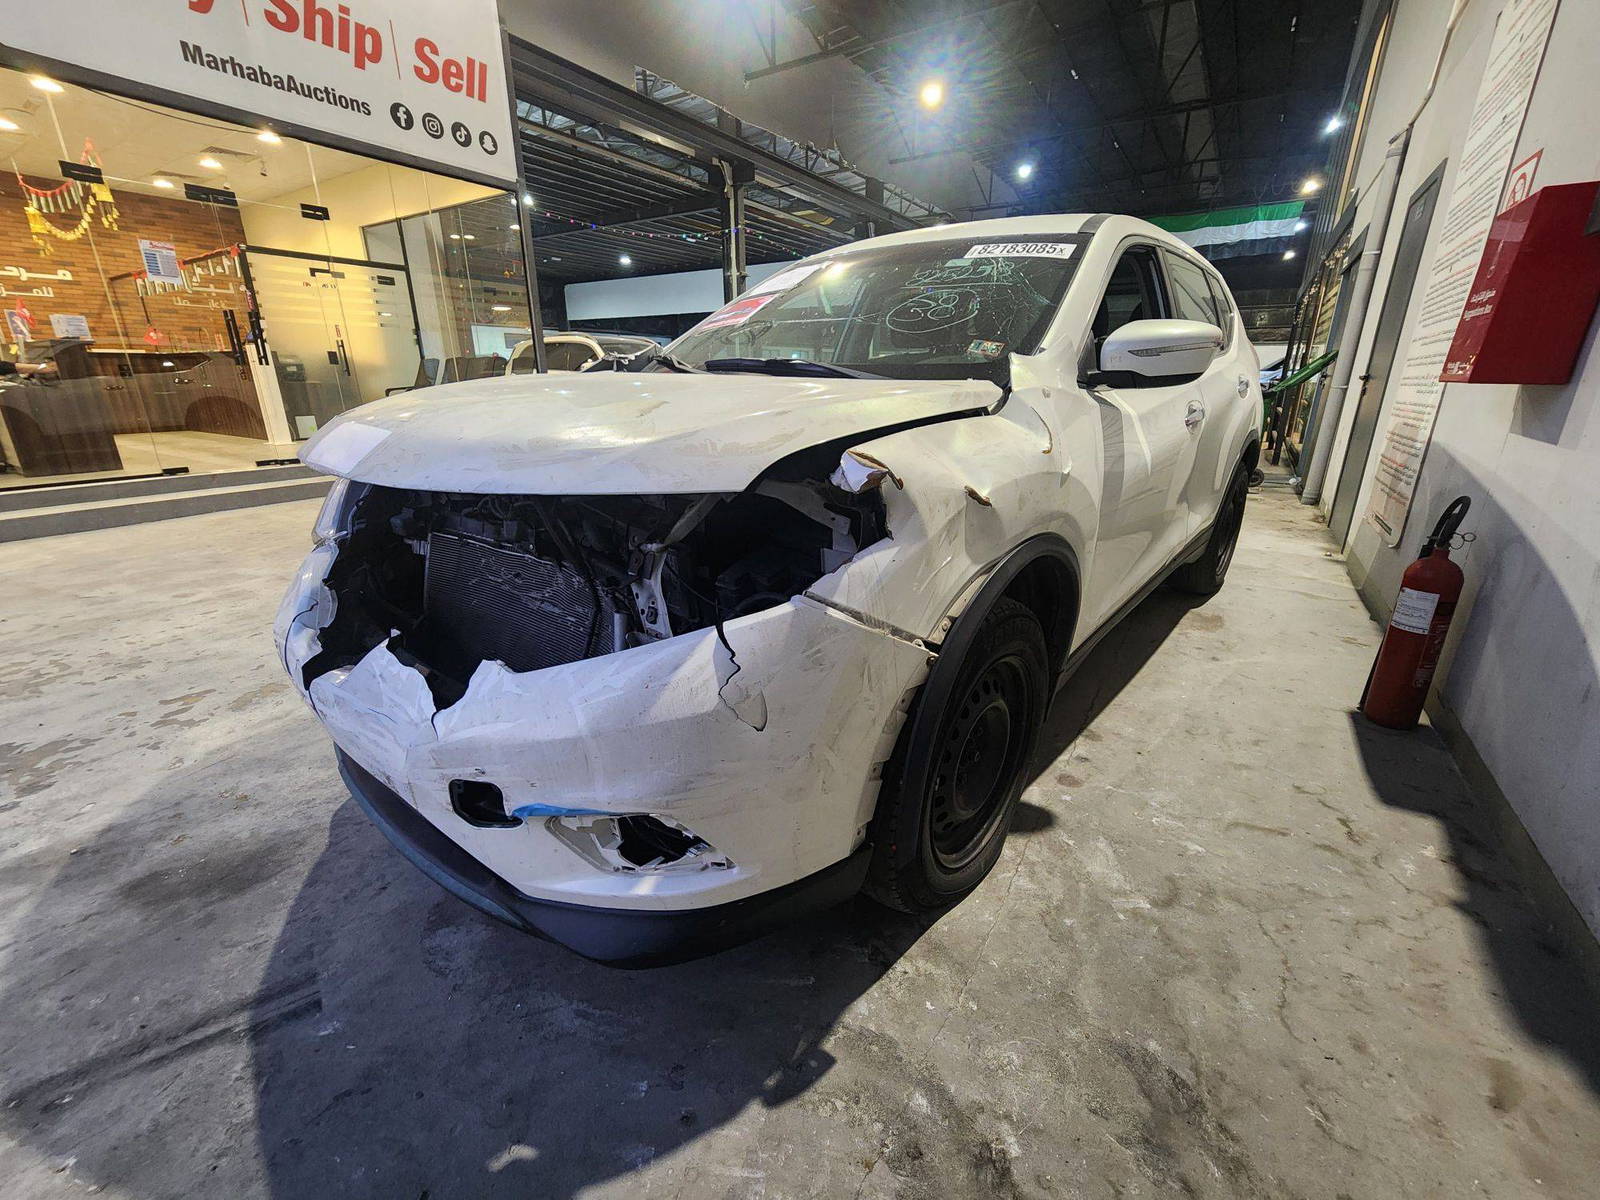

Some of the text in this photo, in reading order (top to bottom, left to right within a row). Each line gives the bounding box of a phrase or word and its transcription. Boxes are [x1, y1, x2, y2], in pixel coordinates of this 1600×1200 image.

[180, 40, 371, 116] MarhabaAuctions
[264, 0, 488, 103] Ship Sell
